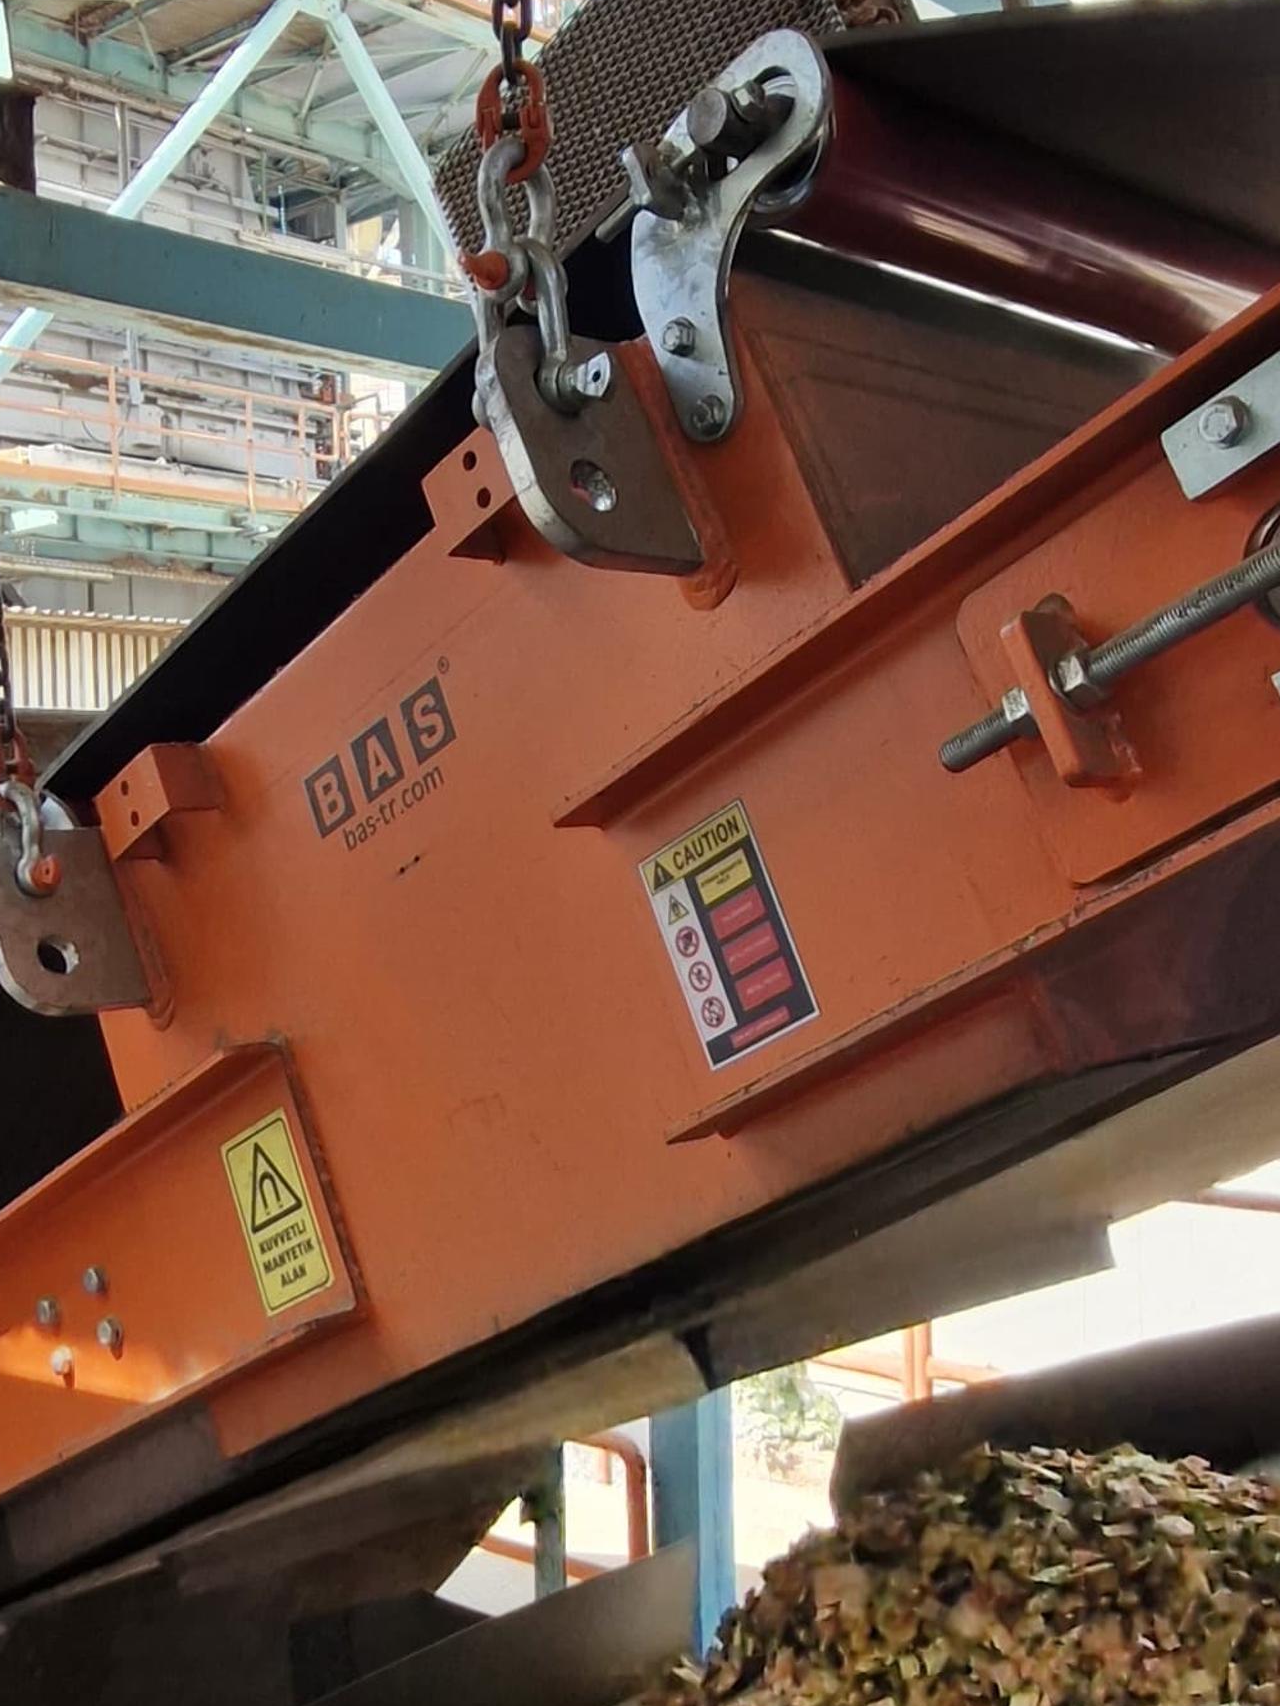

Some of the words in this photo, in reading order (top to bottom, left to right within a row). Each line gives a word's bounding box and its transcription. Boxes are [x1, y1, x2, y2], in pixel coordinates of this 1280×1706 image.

[305, 677, 457, 839] BAS
[343, 766, 445, 851] bas-tr.com
[672, 815, 740, 871] CAUTION
[281, 1263, 307, 1288] ALAN
